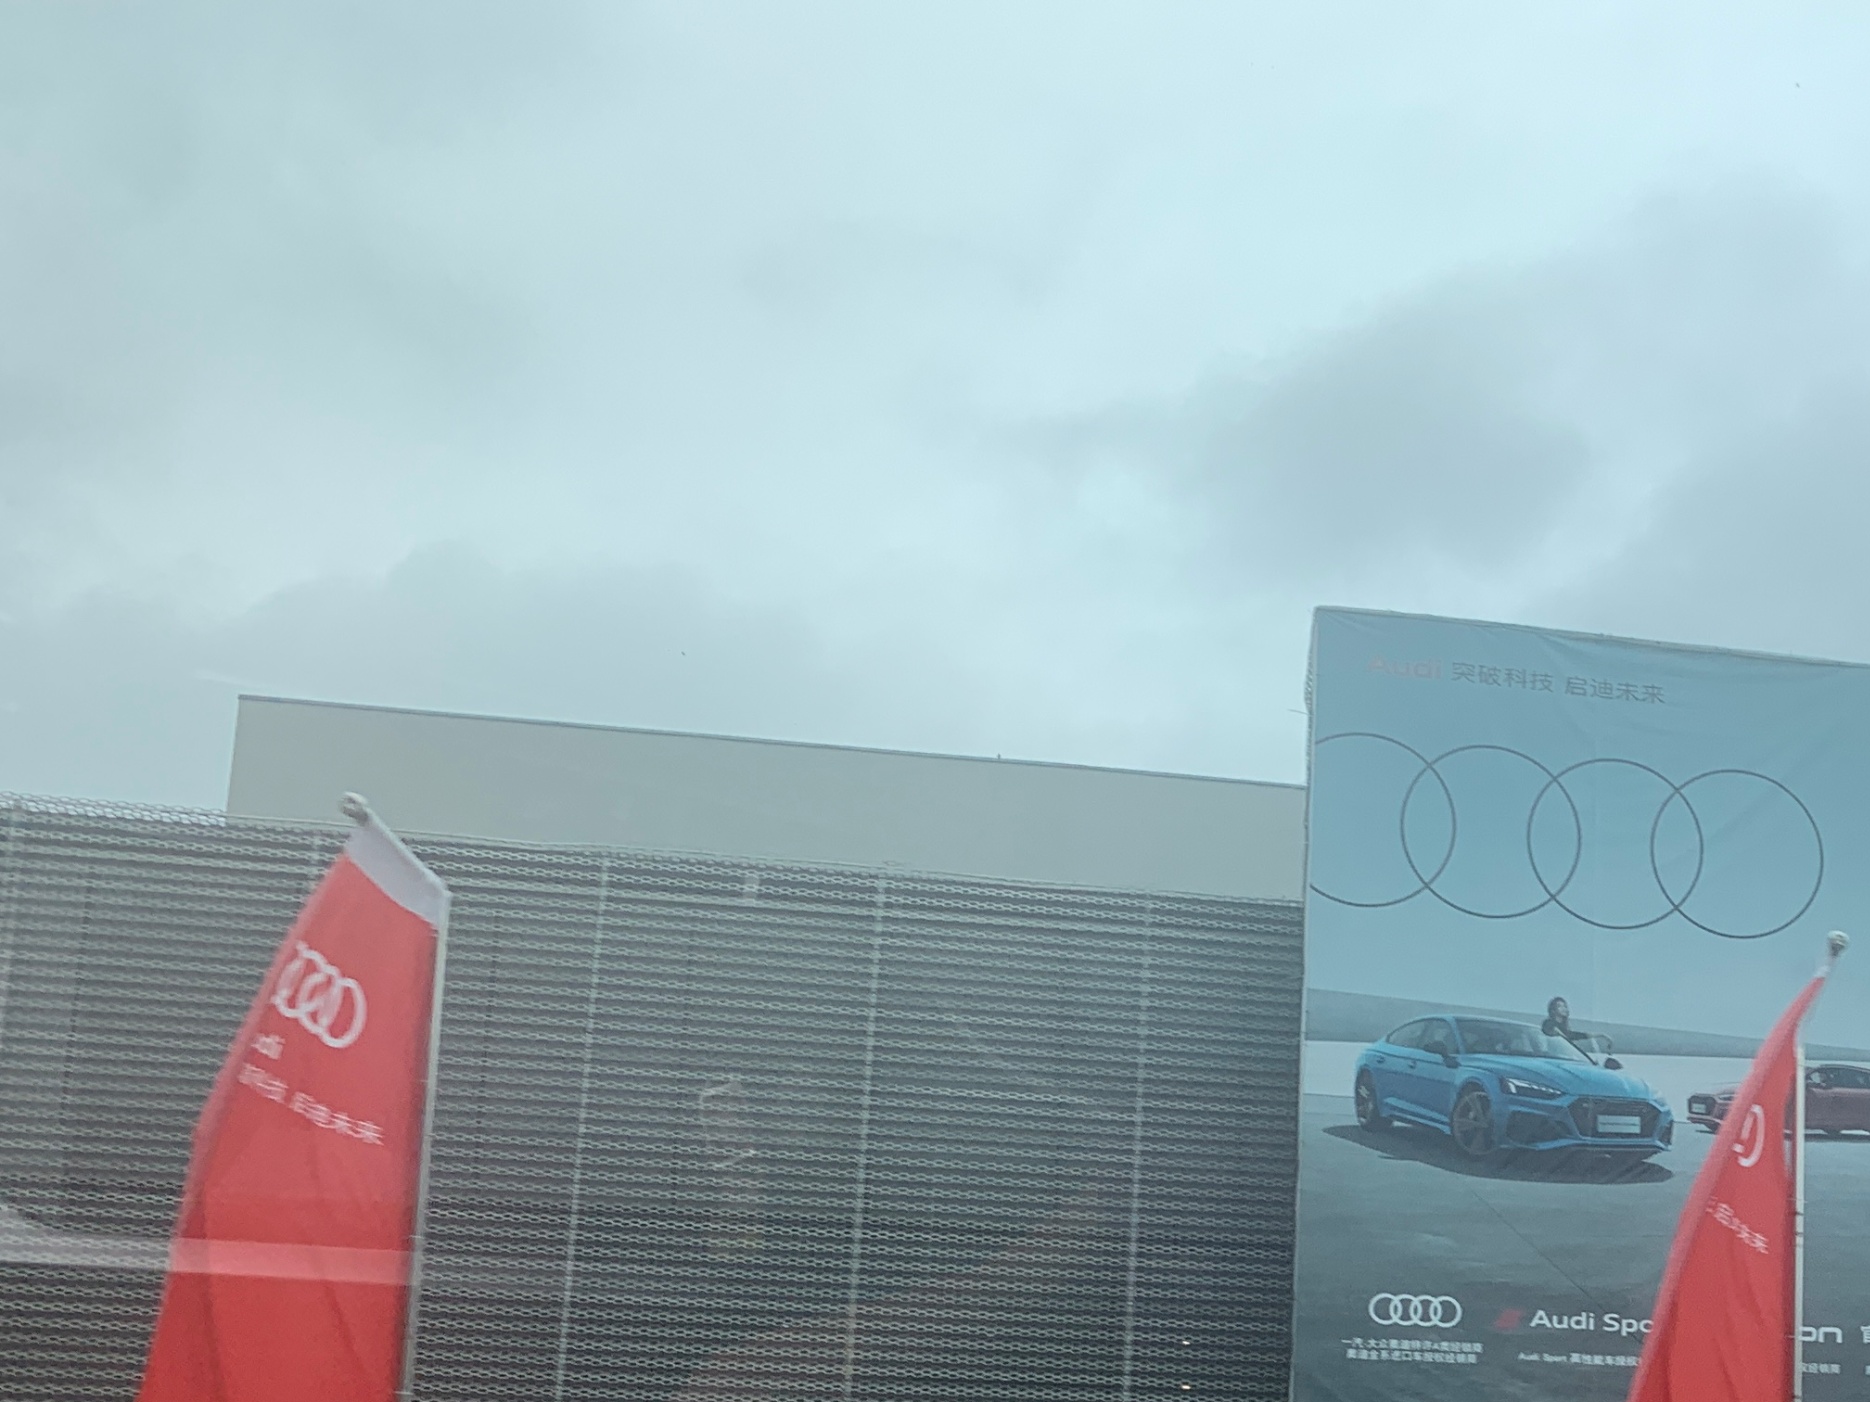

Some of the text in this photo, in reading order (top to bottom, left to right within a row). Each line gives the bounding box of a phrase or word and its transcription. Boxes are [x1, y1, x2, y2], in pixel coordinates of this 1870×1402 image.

[1451, 661, 1555, 694] 突破科技
[1564, 675, 1667, 705] 启迪未来
[1530, 1309, 1655, 1338] Audi Spo
